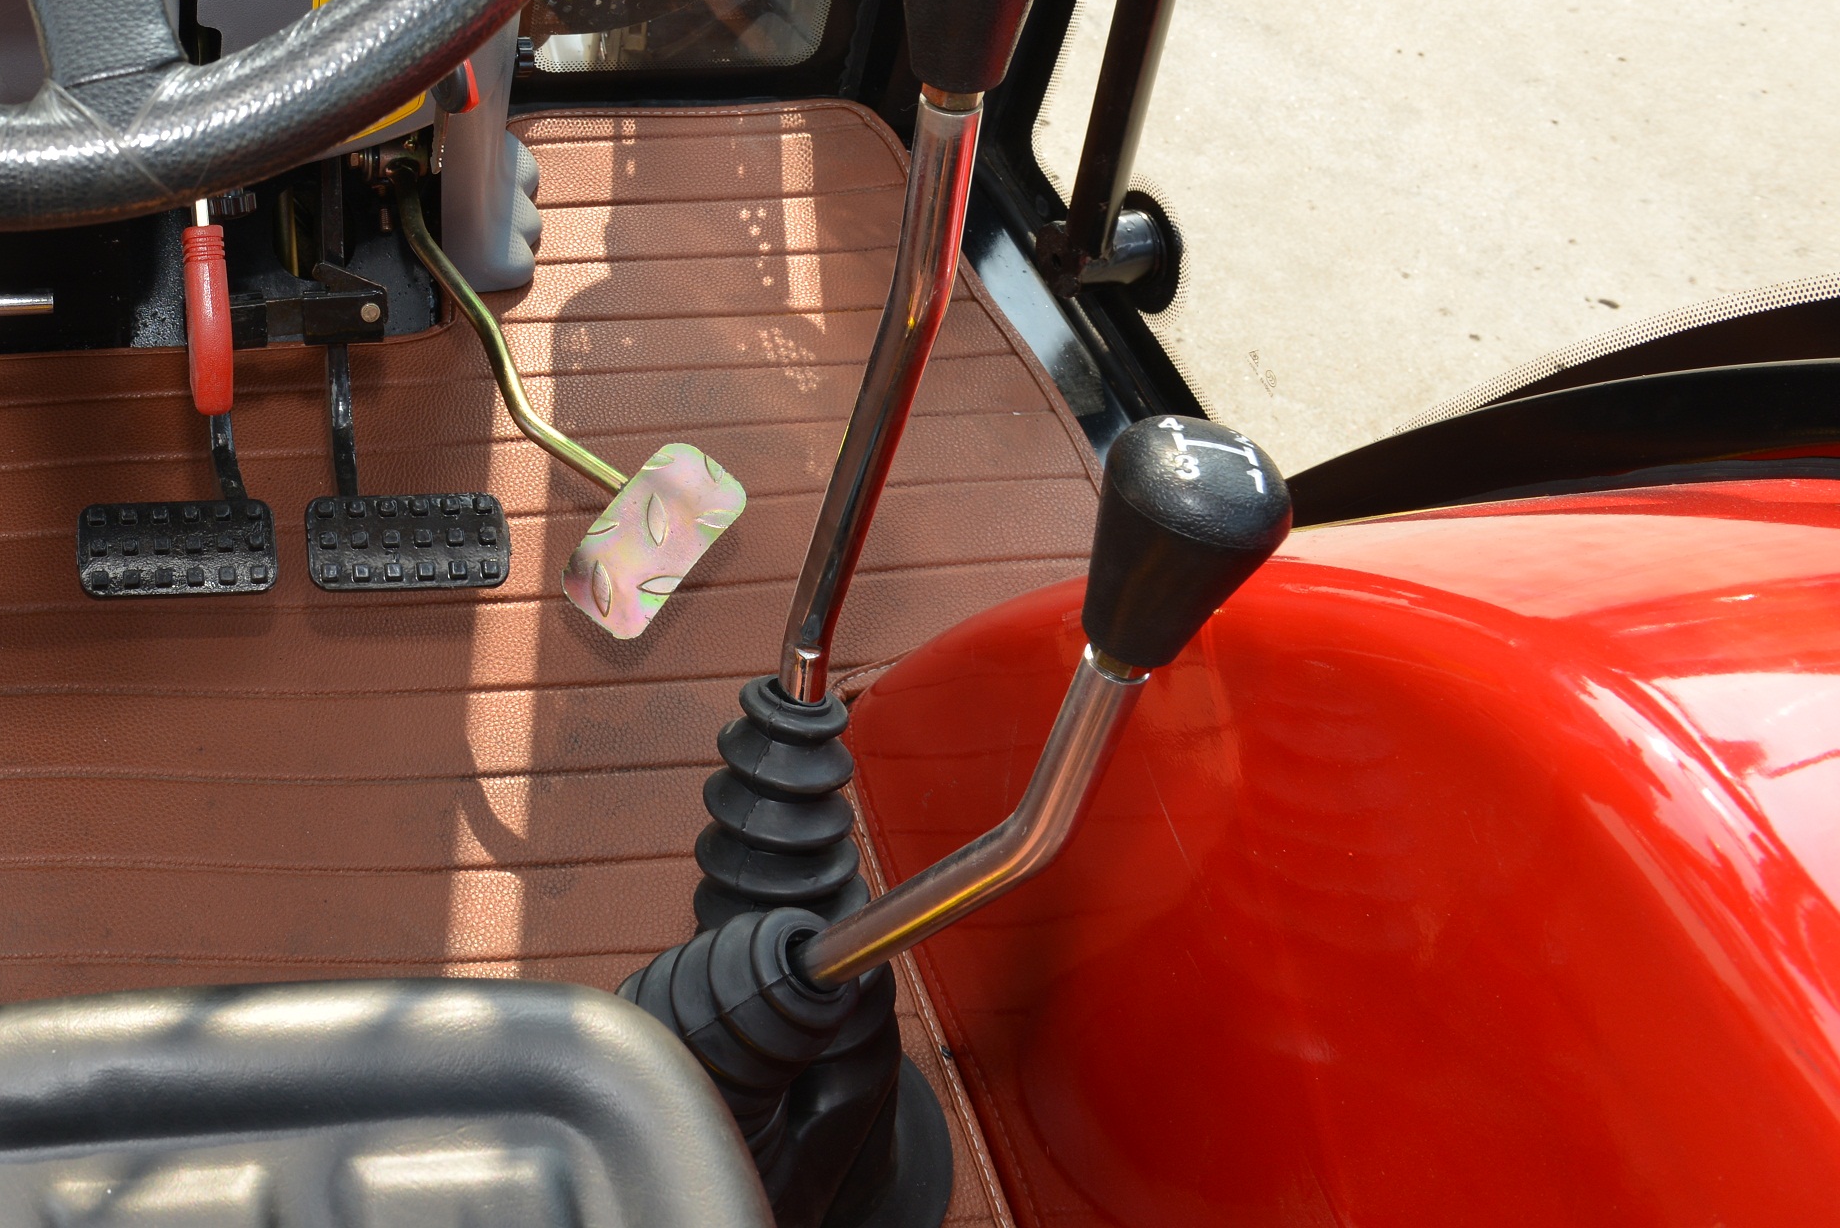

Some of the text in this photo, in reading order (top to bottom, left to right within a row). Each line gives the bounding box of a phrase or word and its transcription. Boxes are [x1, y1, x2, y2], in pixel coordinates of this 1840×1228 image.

[1158, 417, 1185, 431] 4
[1174, 455, 1201, 480] 3
[1245, 468, 1265, 494] 1
